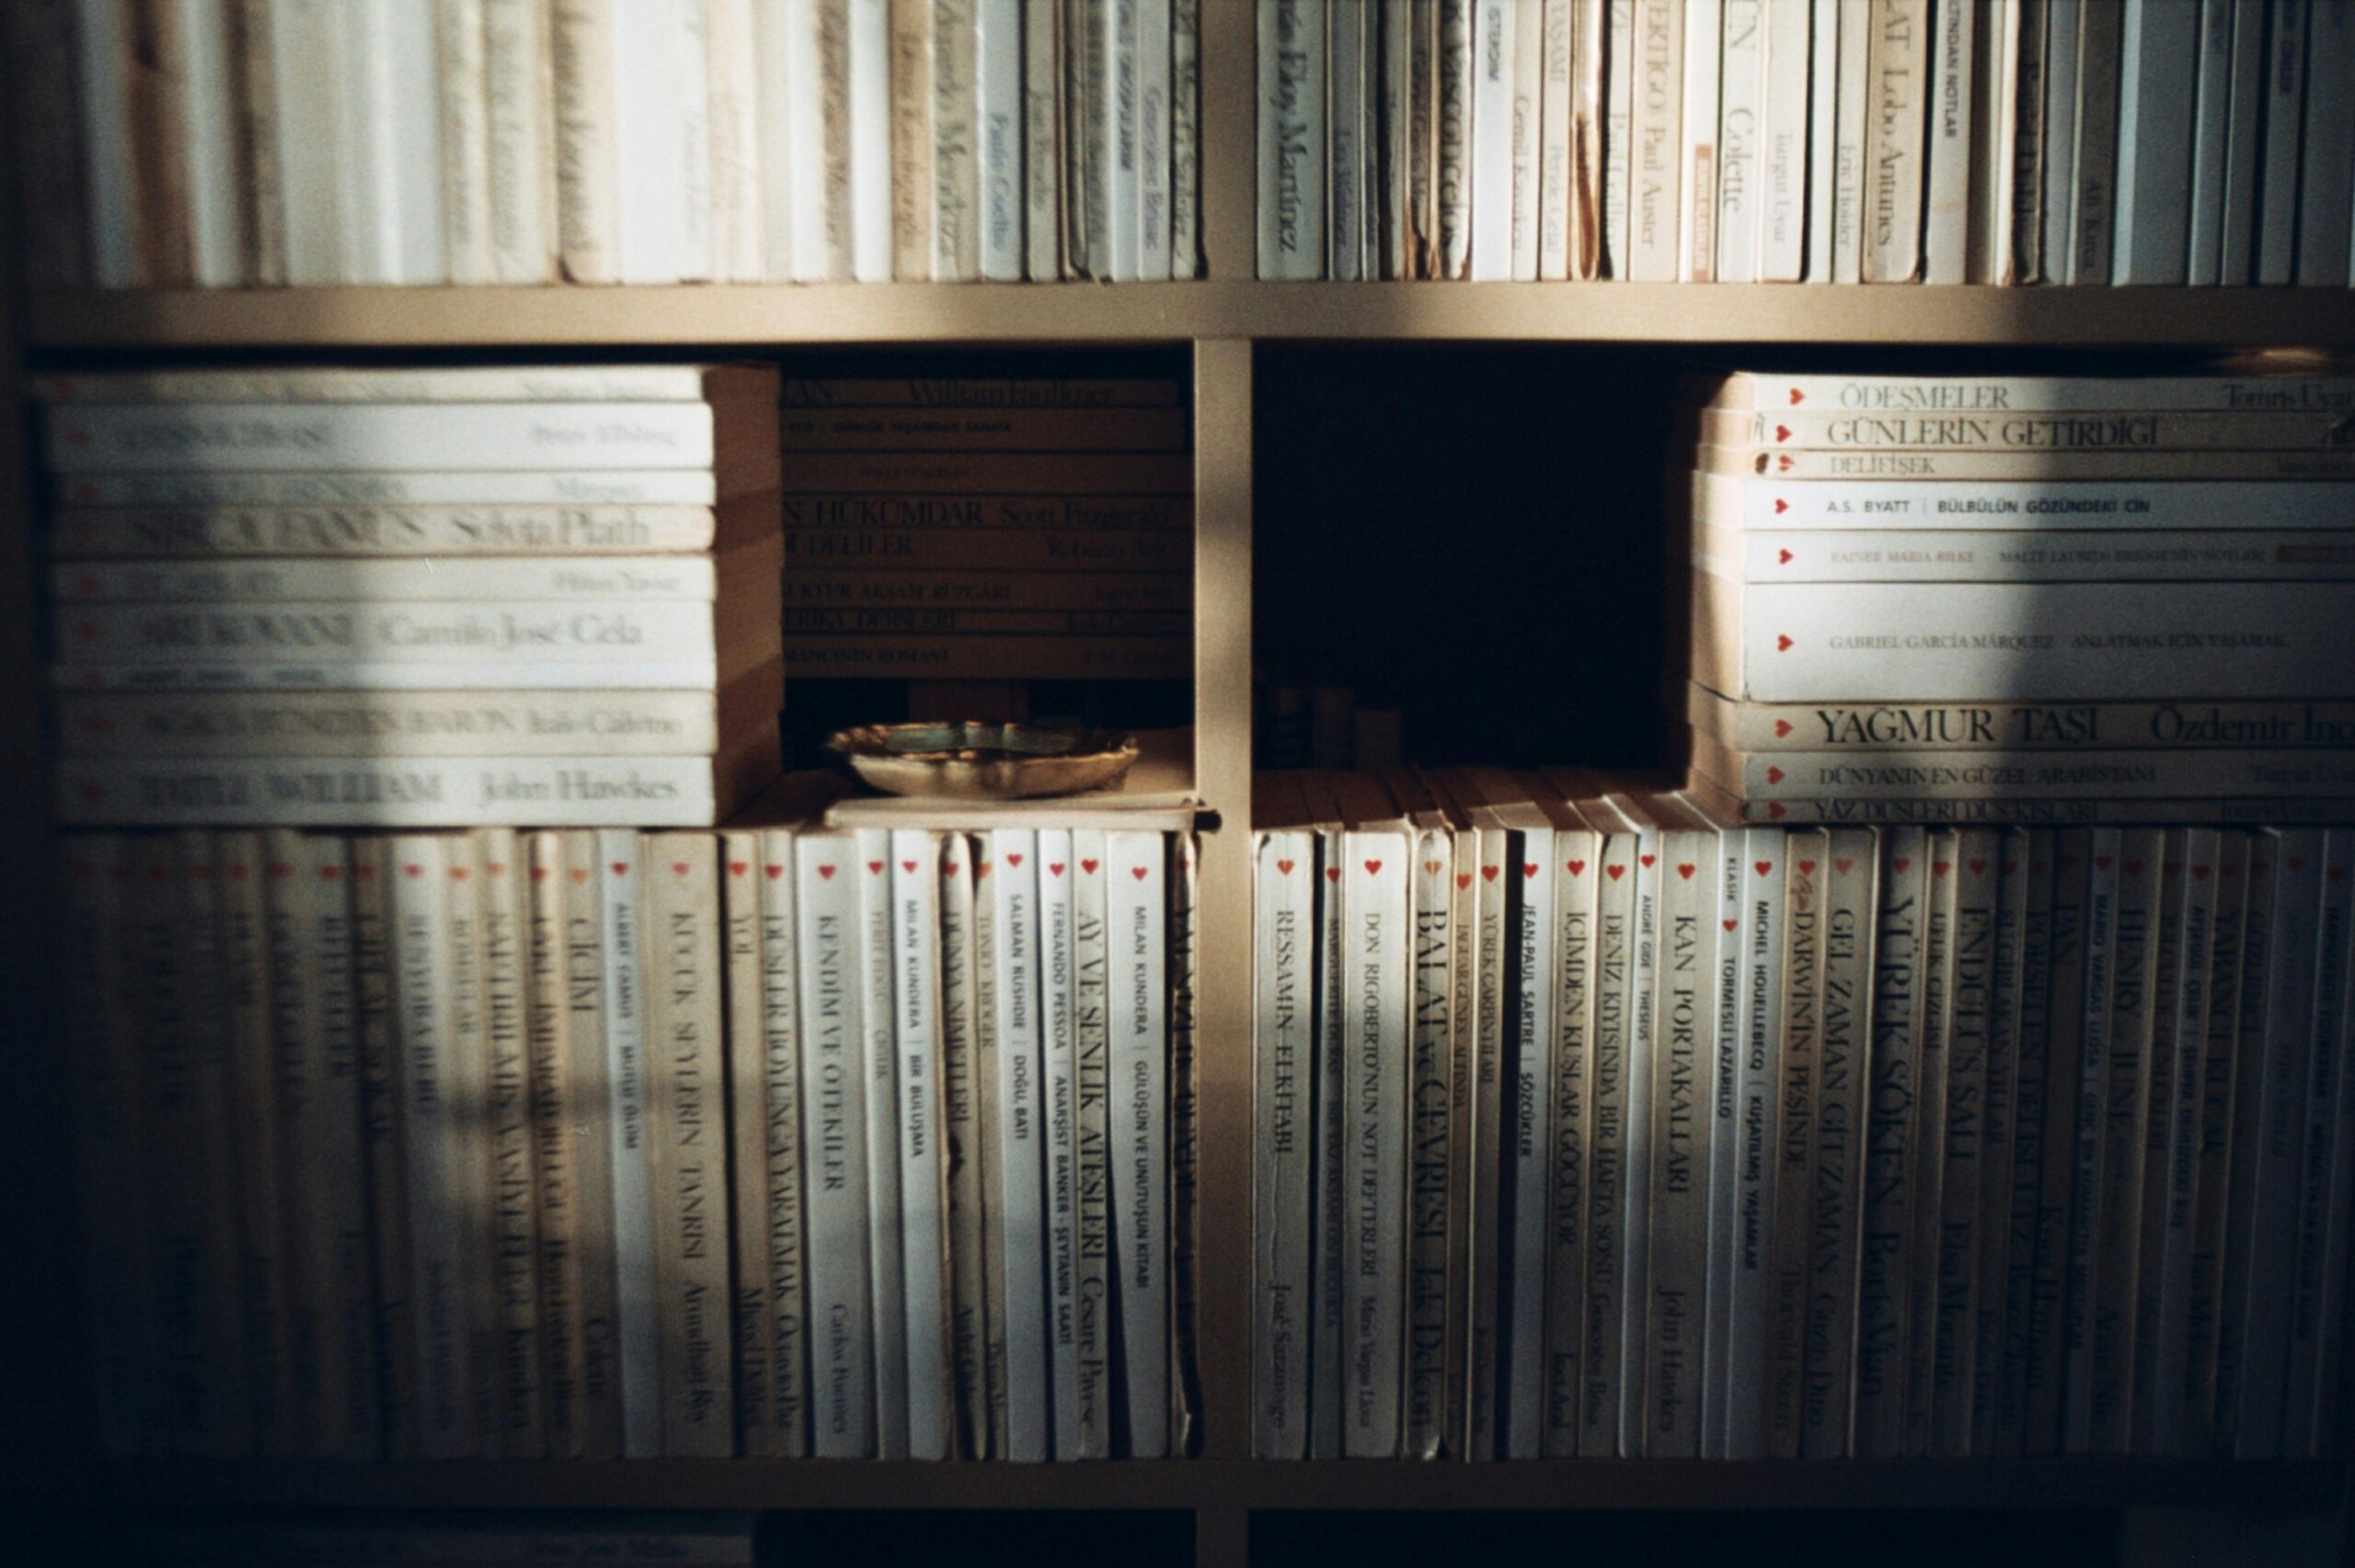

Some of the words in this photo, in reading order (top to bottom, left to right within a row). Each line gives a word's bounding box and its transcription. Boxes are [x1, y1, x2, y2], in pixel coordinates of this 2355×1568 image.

[1881, 69, 1910, 136] Lobo
[1944, 74, 1959, 138] NOTLAR
[1643, 127, 1667, 172] Paul
[1722, 107, 1755, 213] Colette
[1770, 132, 1793, 192] Turgut
[1278, 121, 1308, 253] Martínez
[1640, 177, 1663, 248] Auster
[1877, 143, 1905, 247] Antunes
[1828, 417, 1990, 445] GÜNLERİN
[1841, 383, 2009, 411] ÖDEŞMELER
[1832, 454, 1936, 475] DELİFİŞEK
[816, 498, 983, 525] HÜKÜMDAR
[1865, 499, 1911, 513] BYATT
[1937, 497, 2018, 513] BÜLBÜLÜN
[1830, 635, 1900, 649] GABRIEL
[1816, 707, 1995, 744] YAĞMUR
[2012, 707, 2099, 745] TAŞI
[2149, 701, 2297, 742] Özdemir
[1820, 765, 1926, 784] DÜNYANIN
[1933, 768, 1960, 784] EN
[1962, 765, 2025, 784] GÜZEL
[905, 899, 918, 948] MILAN
[1010, 894, 1026, 958] SALMAN
[1051, 901, 1067, 984] FERNANDO
[1078, 911, 1104, 948] AY
[1134, 906, 1148, 955] MILAN
[1363, 913, 1381, 955] DON
[1482, 914, 1499, 969] YÜREK
[1521, 903, 1536, 983] JEAN-PAUL
[1604, 913, 1626, 983] DENİZ
[1640, 895, 1654, 935] ANDRÉ
[1674, 915, 1697, 972] KAN
[1755, 900, 1770, 956] MICHEL
[1828, 908, 1856, 970] GEL
[2092, 893, 2109, 948] MARIO
[819, 916, 844, 1016] KENDİM
[1078, 957, 1103, 997] VE
[1276, 910, 1295, 1031] RESSAMIN
[1416, 910, 1448, 1035] BALAT
[1564, 911, 1589, 1015] İÇİMDEN
[1639, 941, 1651, 969] GIDE
[1790, 910, 1818, 1053] DARWİN'İN
[1877, 896, 1920, 1046] YÜREK
[2088, 952, 2107, 1013] VARGAS
[2113, 908, 2145, 1018] HENRY
[906, 956, 921, 1029] KUNDERA
[1012, 966, 1028, 1029] RUSHDIE
[1052, 992, 1068, 1049] PESSOA
[1133, 963, 1149, 1035] KUNDERA
[1521, 991, 1534, 1046] SARTRE
[1637, 990, 1650, 1041] THESEUS
[1721, 956, 1738, 1034] TORMESLİ
[1750, 963, 1768, 1071] HOUELLEBECQ
[1951, 906, 1991, 1073] ENDÜLÜS
[821, 1025, 842, 1056] VE
[909, 1054, 925, 1078] BİR
[1075, 1005, 1108, 1111] ŞENLİK
[1362, 964, 1381, 1116] RIGOBERTO'NUN
[1599, 991, 1623, 1097] KIYISINDA
[1824, 979, 1854, 1092] ZAMAN
[1131, 1060, 1152, 1131] GÜLÜŞÜN
[1274, 1045, 1297, 1153] ELKİTABI
[1560, 1025, 1584, 1119] KUŞLAR
[1667, 988, 1694, 1195] PORTAKALLARI
[1718, 1036, 1734, 1120] LAZARILLO
[822, 1063, 849, 1192] ÖTEKİLER
[907, 1085, 925, 1158] BULUŞMA
[1014, 1107, 1028, 1140] BATI
[1052, 1076, 1071, 1147] ANARŞİST
[1134, 1135, 1149, 1154] VE
[1361, 1122, 1378, 1162] NOT
[1518, 1072, 1534, 1158] SÖZCÜKLER
[1598, 1105, 1621, 1140] BİR
[1744, 1095, 1764, 1183] KUŞATILMIŞ
[1783, 1064, 1810, 1172] PEŞİNDE
[1821, 1103, 1850, 1161] GİT
[1867, 1058, 1915, 1208] SÖKEN
[1055, 1155, 1071, 1213] BANKER
[1076, 1126, 1109, 1259] ATEŞLERİ
[1132, 1157, 1151, 1239] UNUTUŞUN
[1556, 1128, 1582, 1247] GÖÇÜYOR
[1595, 1149, 1617, 1219] HAFTA
[1360, 1169, 1379, 1276] DEFTERLERİ
[1593, 1223, 1615, 1285] SONU
[1742, 1189, 1762, 1270] YAŞAMLAR
[1813, 1165, 1844, 1276] ZAMAN
[1054, 1227, 1073, 1296] ŞEYTANIN
[1135, 1243, 1153, 1288] KİTABI
[1411, 1257, 1448, 1313] Jak
[829, 1303, 850, 1363] Carlos
[1057, 1303, 1074, 1345] SAATİ
[1080, 1276, 1105, 1352] Cesare
[1268, 1284, 1292, 1325] José
[1657, 1287, 1687, 1343] John
[1266, 1331, 1289, 1431] Saramago
[1659, 1348, 1683, 1435] Hawkes
[1774, 1369, 1798, 1430] Steen
